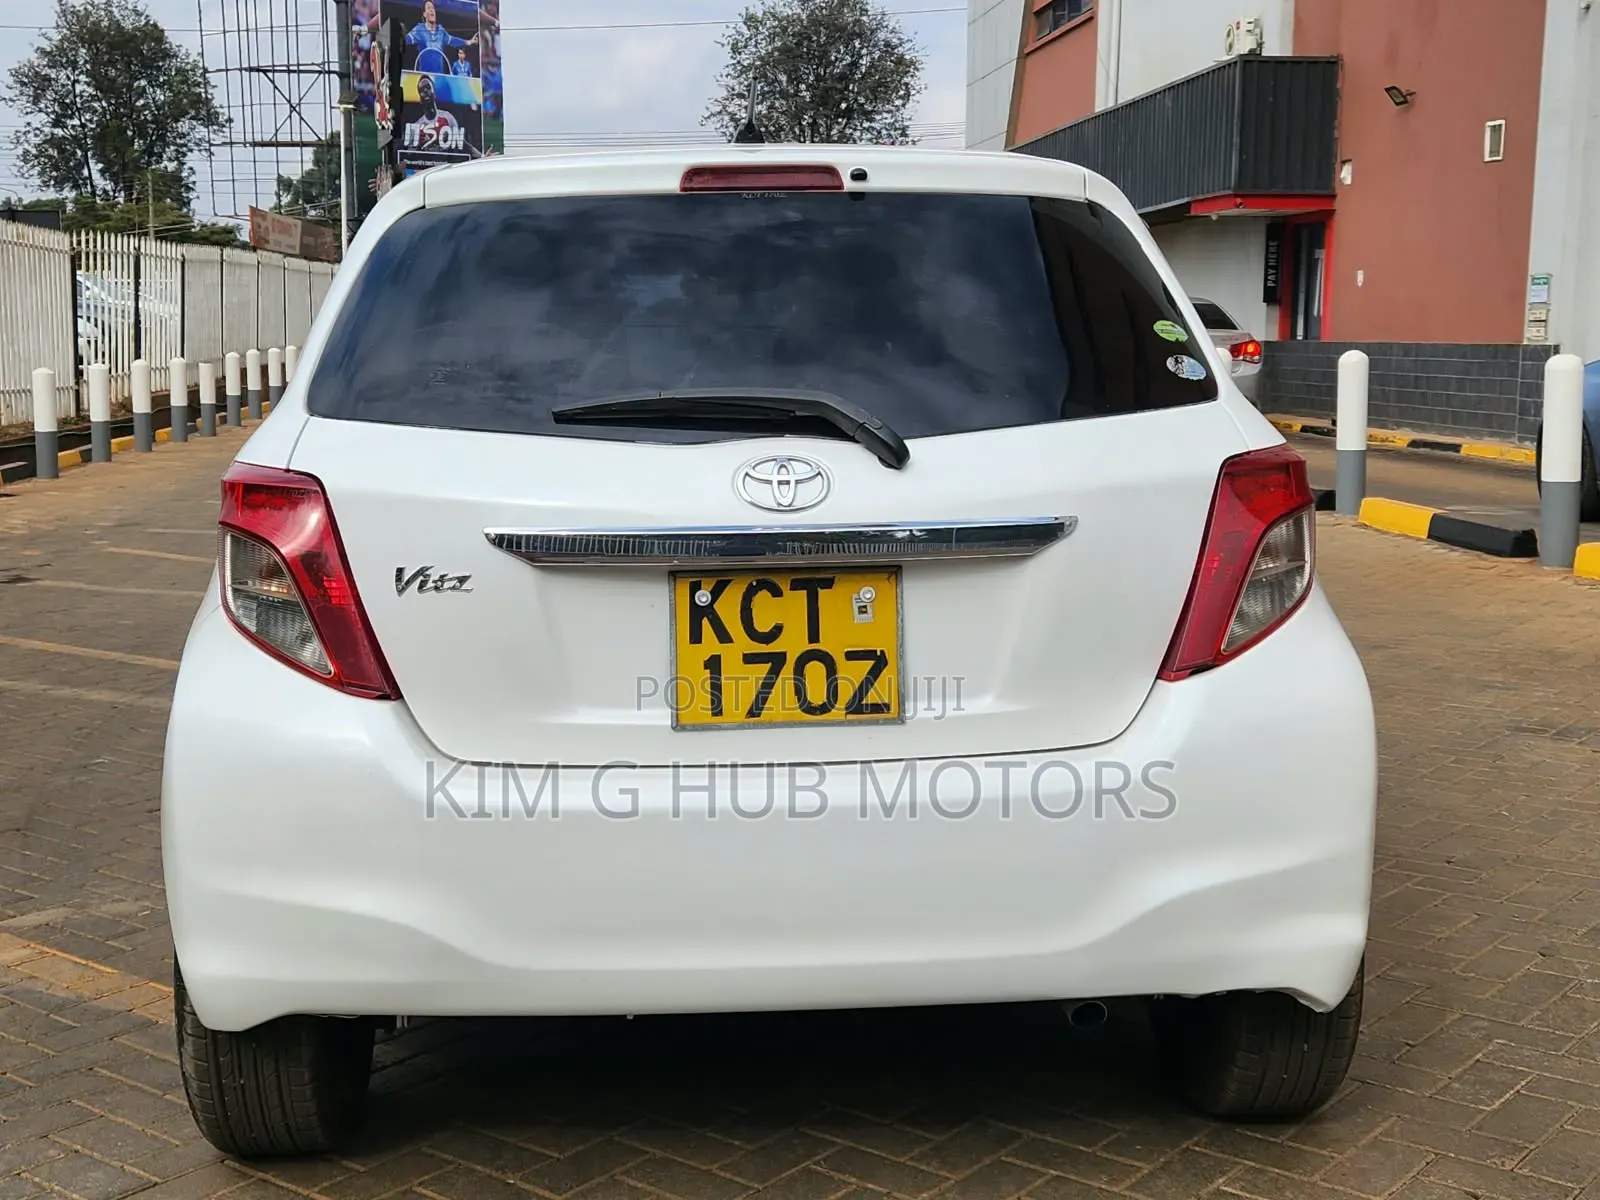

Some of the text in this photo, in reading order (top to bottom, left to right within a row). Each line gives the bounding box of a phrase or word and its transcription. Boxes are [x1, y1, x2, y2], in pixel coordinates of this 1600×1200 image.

[438, 125, 465, 150] ON
[1267, 240, 1278, 287] PAY HERE
[395, 565, 474, 598] Vitz
[688, 575, 836, 646] KCT
[703, 648, 891, 719] 170Z
